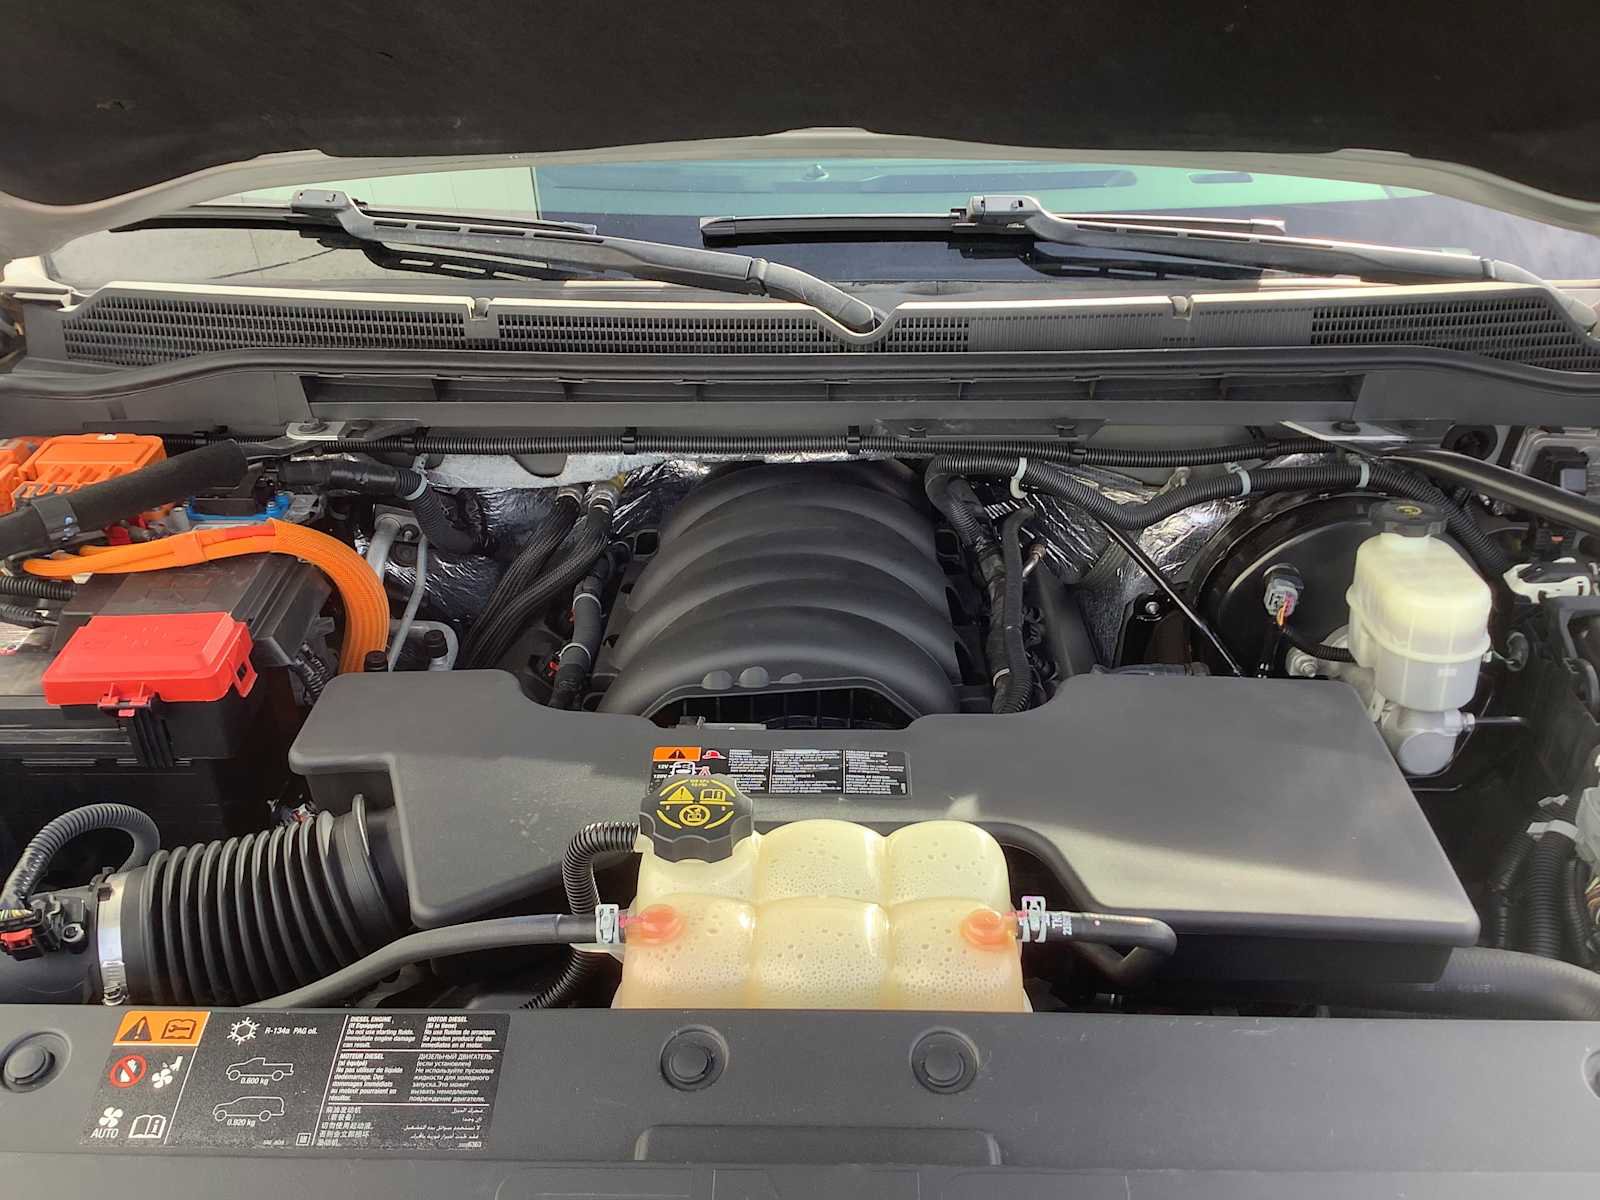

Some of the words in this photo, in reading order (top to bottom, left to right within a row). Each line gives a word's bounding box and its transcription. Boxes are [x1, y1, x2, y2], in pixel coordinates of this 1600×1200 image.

[260, 1077, 269, 1086] kg
[247, 1119, 256, 1128] kg
[90, 1128, 119, 1138] AUTO
